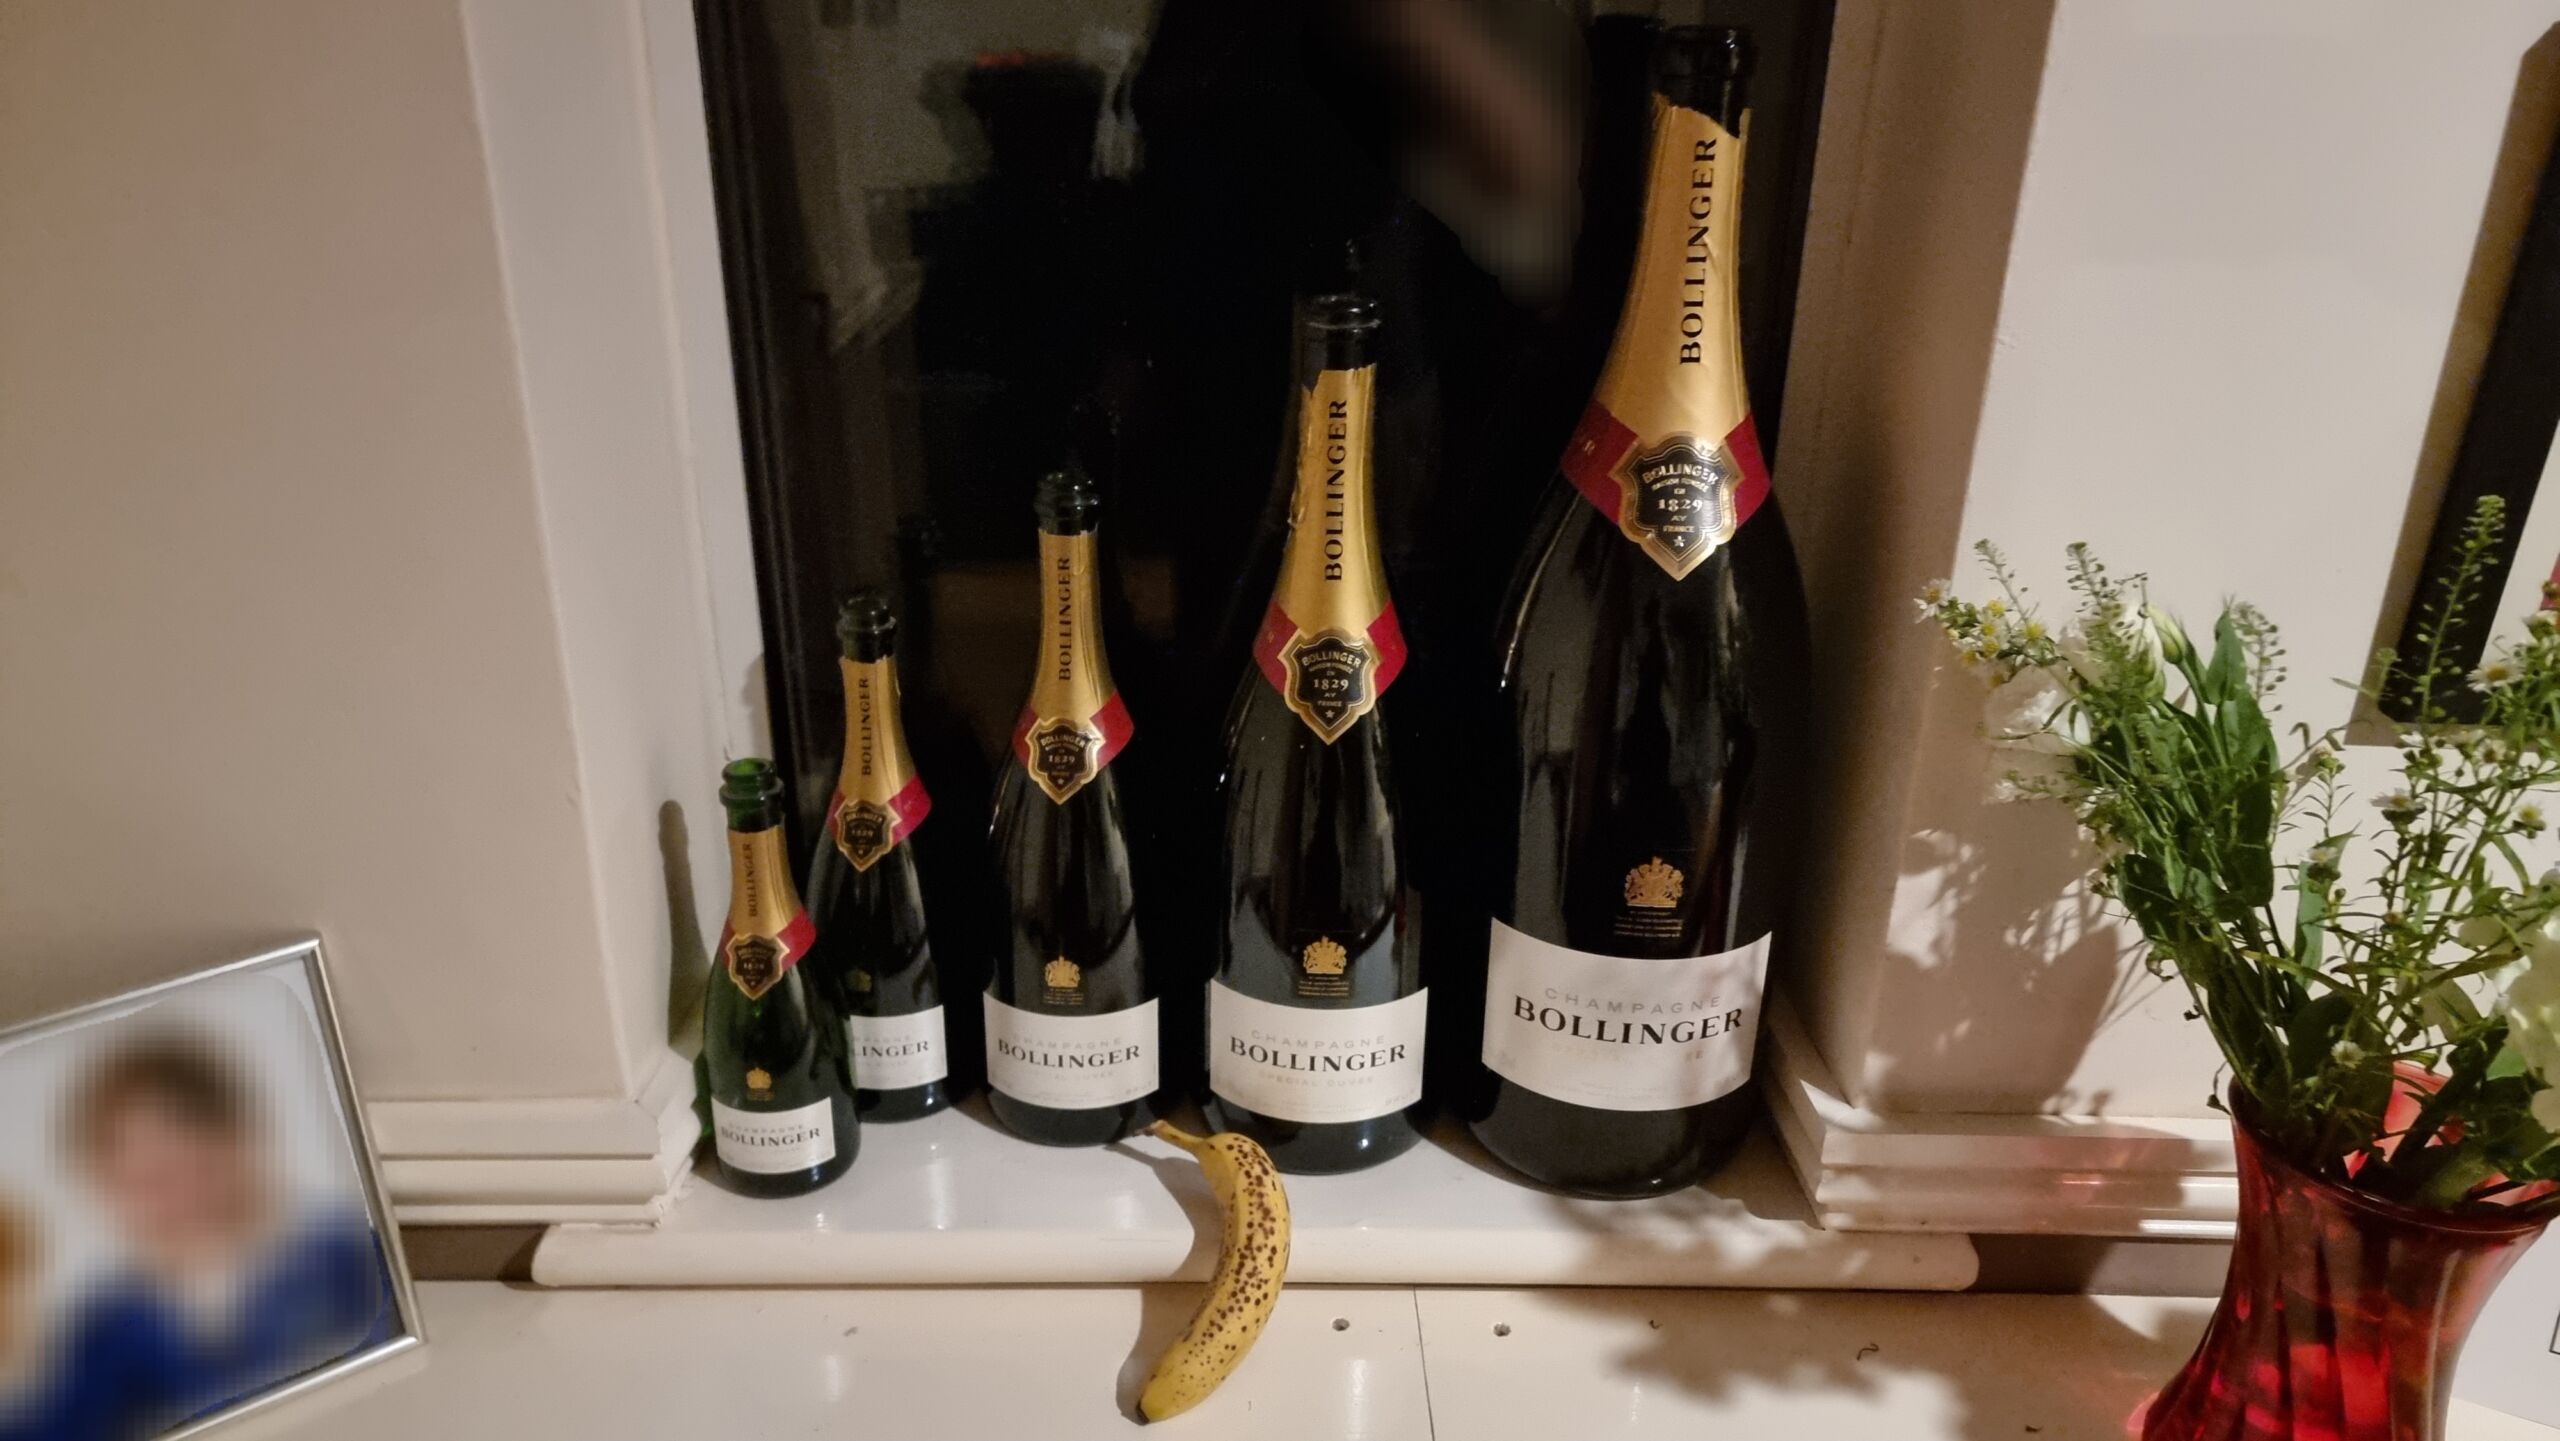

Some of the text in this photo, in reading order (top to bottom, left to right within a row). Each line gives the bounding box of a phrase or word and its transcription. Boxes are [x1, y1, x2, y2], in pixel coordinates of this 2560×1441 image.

[1680, 137, 1717, 365] BOLLINGER
[1324, 399, 1348, 581] BOLLINGER
[1642, 463, 1719, 485] BOLLINGER
[1657, 498, 1703, 513] 1829
[1056, 557, 1073, 681] BOLLINGER
[1301, 651, 1361, 668] BOLLINGER
[1313, 678, 1350, 692] 1829
[858, 677, 872, 776] BOLLINGER
[741, 843, 758, 917] BOLLINGER
[1545, 987, 1721, 1014] CHAMPAGNE
[1513, 995, 1743, 1045] BOLLINGER
[998, 1037, 1141, 1069] BOLLINGER
[1229, 1035, 1406, 1072] BOLLINGER
[1250, 1029, 1386, 1049] CHAMPAGNE
[721, 1125, 821, 1147] BOLLINGER
